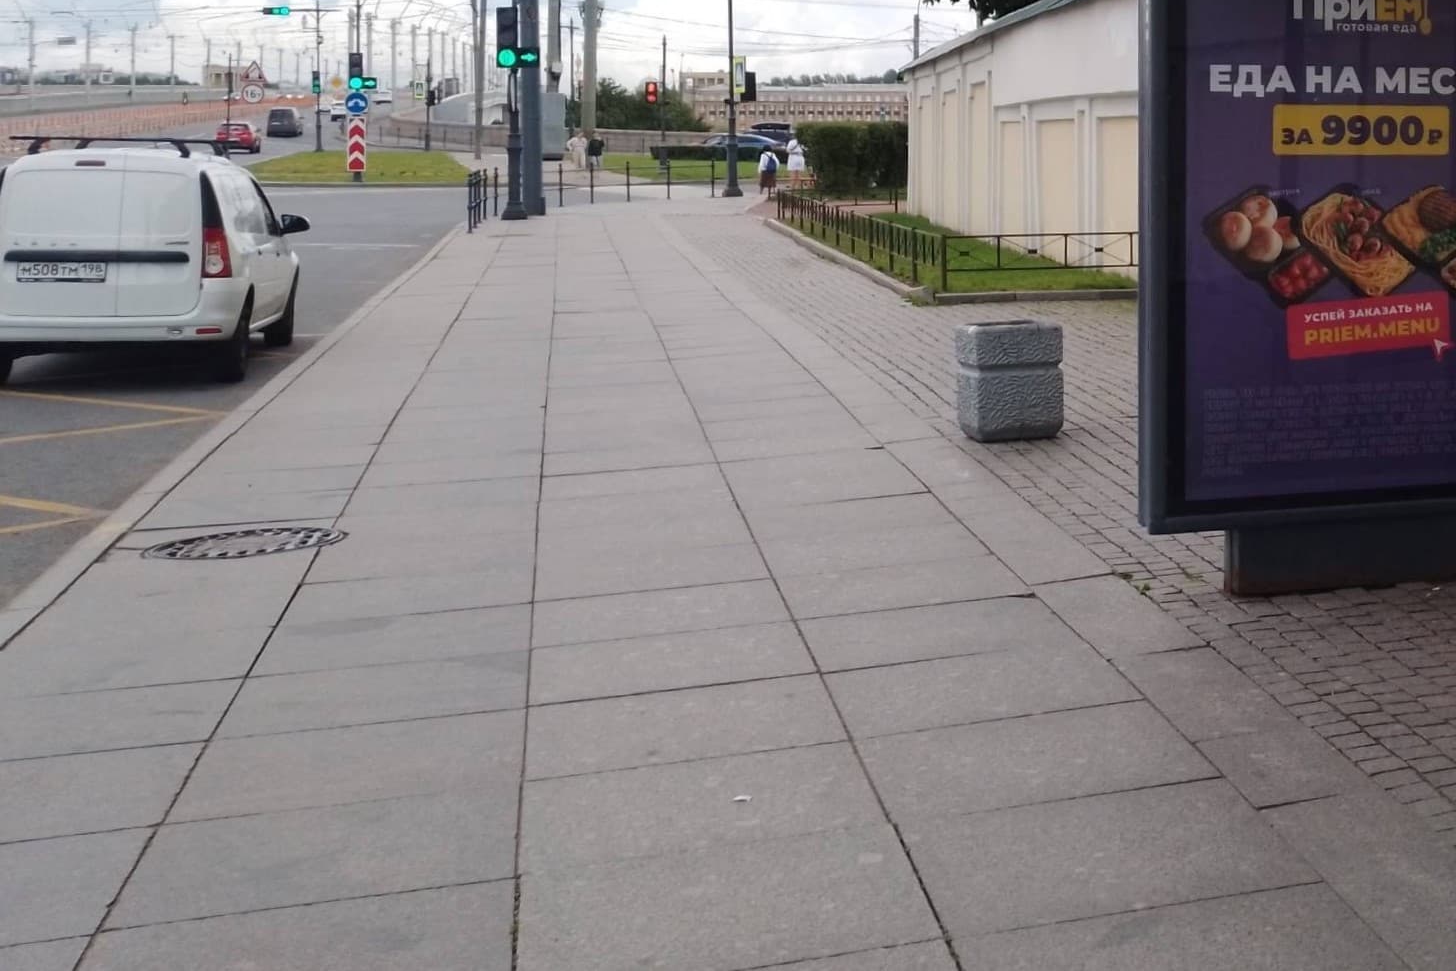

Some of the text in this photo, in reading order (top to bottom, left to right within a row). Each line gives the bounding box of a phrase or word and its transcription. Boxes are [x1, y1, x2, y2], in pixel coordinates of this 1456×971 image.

[1336, 23, 1417, 33] готовая еда
[1208, 64, 1296, 98] ЕДА
[1306, 66, 1363, 94] НА
[1281, 128, 1313, 145] ЗА
[1304, 302, 1433, 323] УСПЕЙ ЗАКАЗАТЬ НА
[1304, 317, 1440, 346] PRIEM.MENU
